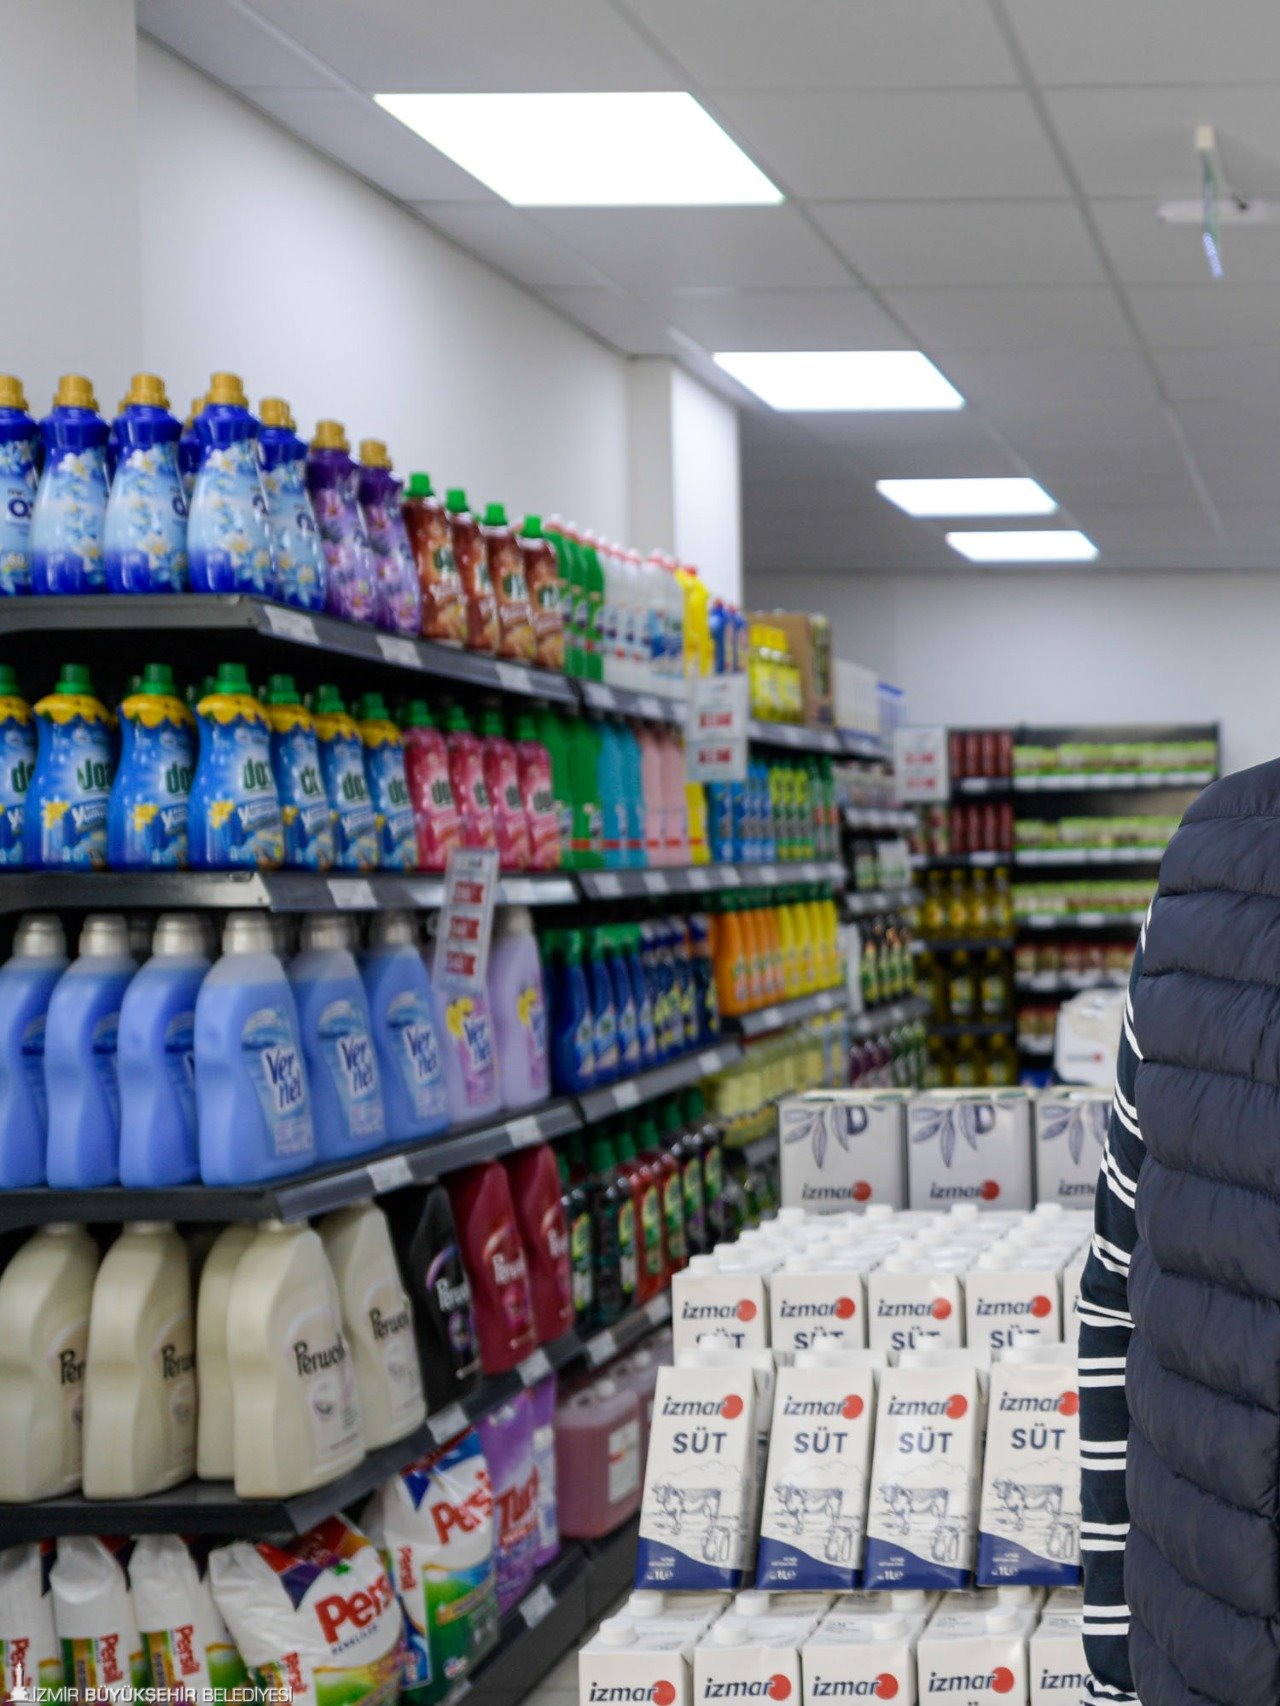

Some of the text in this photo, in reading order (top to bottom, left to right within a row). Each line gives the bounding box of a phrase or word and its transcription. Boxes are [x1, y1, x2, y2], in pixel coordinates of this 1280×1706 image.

[1057, 1179, 1096, 1197] izm
[662, 1396, 727, 1416] izmar
[783, 1396, 847, 1416] izmar
[888, 1396, 953, 1416] izmar
[1000, 1391, 1064, 1412] izmar
[672, 1427, 727, 1453] SÜT
[794, 1427, 848, 1453] SÜT
[898, 1426, 953, 1453] SÜT
[1011, 1423, 1066, 1450] SÜT
[704, 1678, 776, 1698] izmar
[812, 1676, 881, 1697] izmar
[928, 1672, 997, 1693] izmar
[1040, 1669, 1091, 1690] izm
[589, 1682, 659, 1702] izmar
